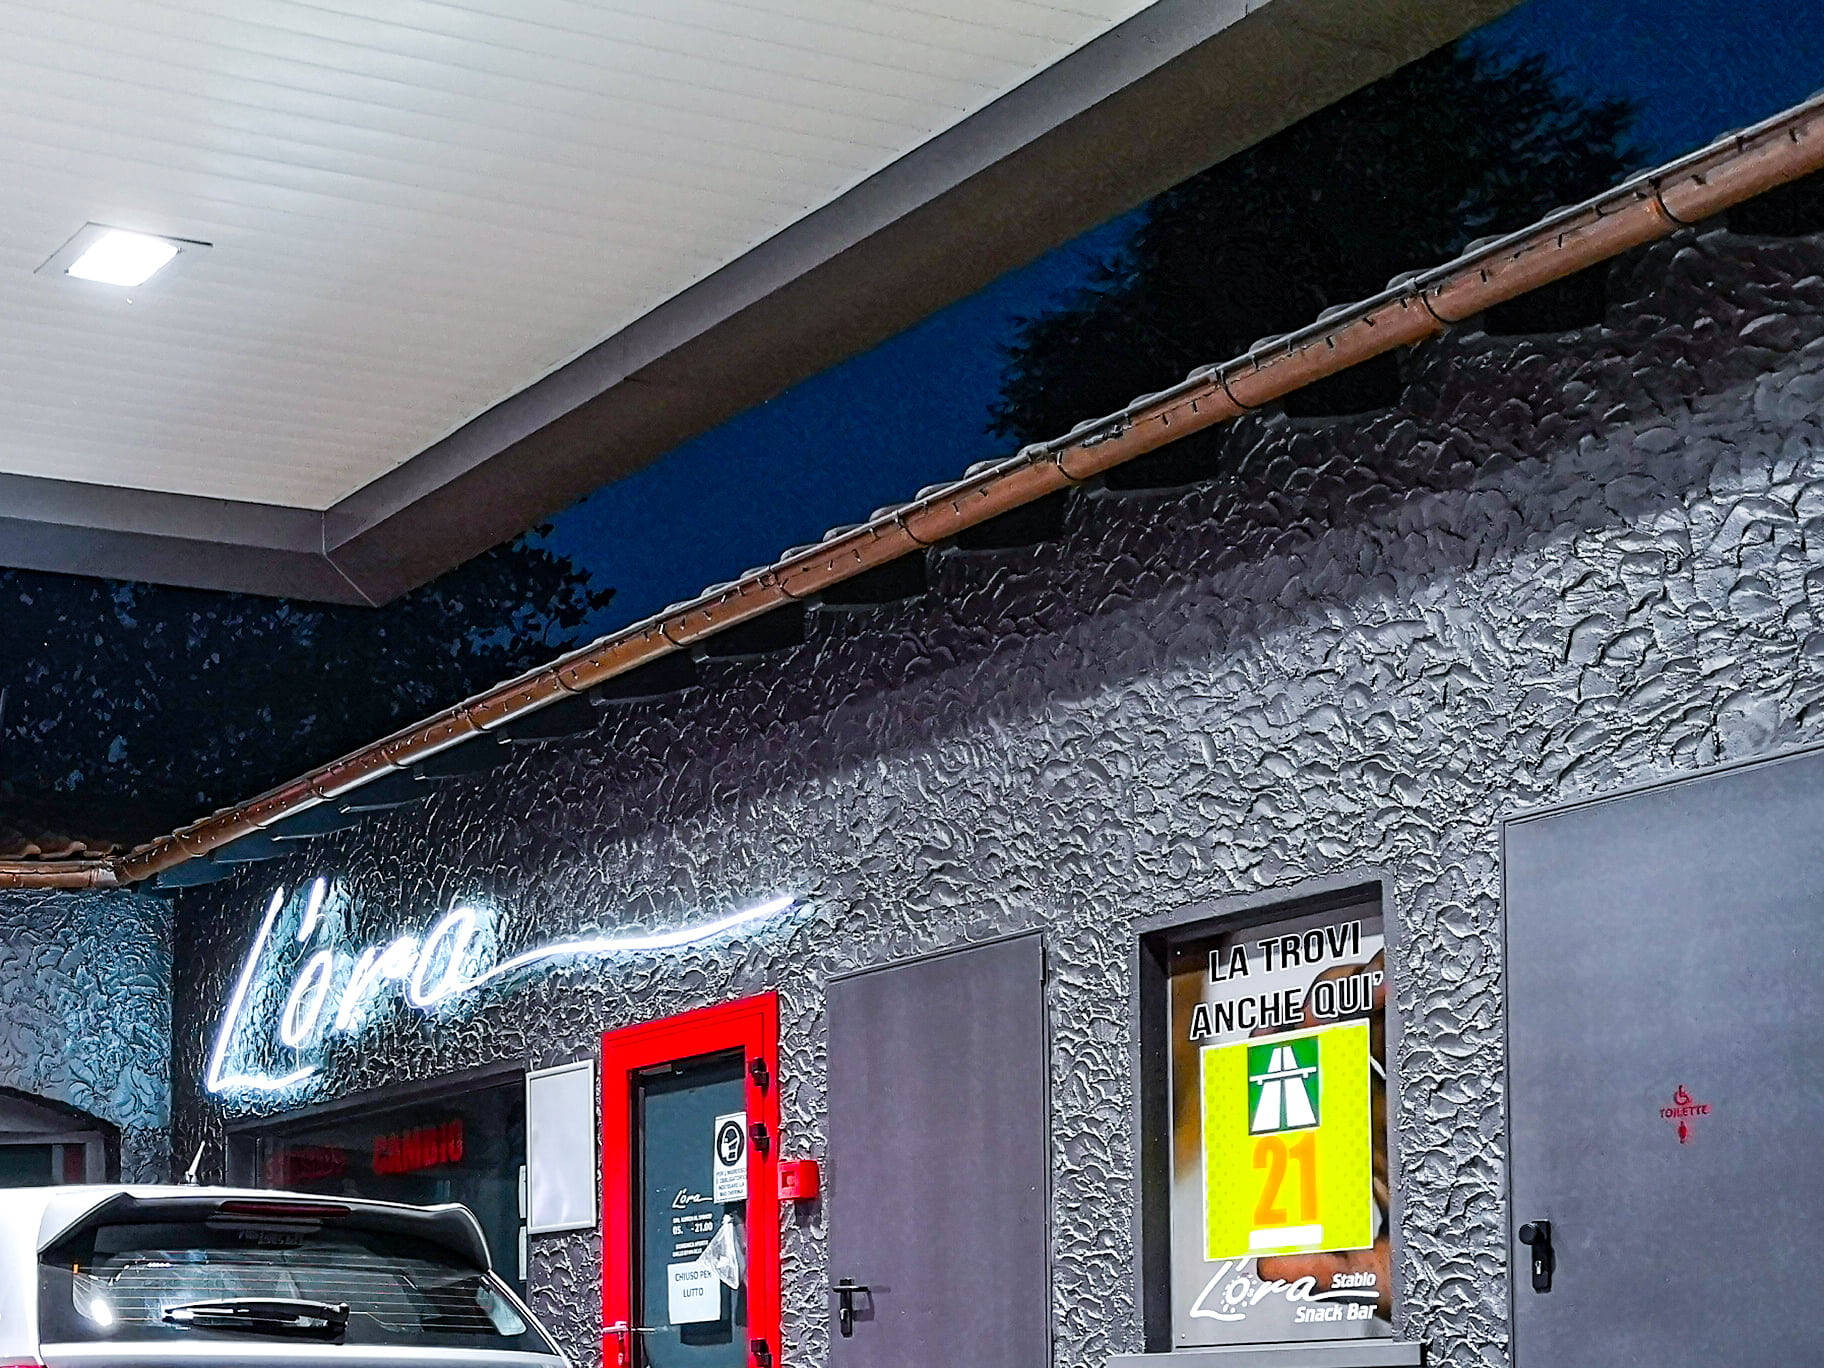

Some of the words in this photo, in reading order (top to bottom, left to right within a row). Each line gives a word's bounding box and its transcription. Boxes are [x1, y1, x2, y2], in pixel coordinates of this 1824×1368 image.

[1209, 944, 1249, 985] LA
[1258, 920, 1362, 974] TROVI
[1189, 987, 1306, 1040] ANCHE
[1310, 971, 1384, 1020] QUI'
[1660, 1105, 1710, 1118] TOILETTE
[1253, 1132, 1318, 1226] 21
[675, 1270, 698, 1282] CHIUSO
[1331, 1272, 1377, 1288] Stabio
[683, 1287, 704, 1298] LUTTO
[1294, 1304, 1344, 1323] Snack
[1347, 1302, 1378, 1320] Bar
